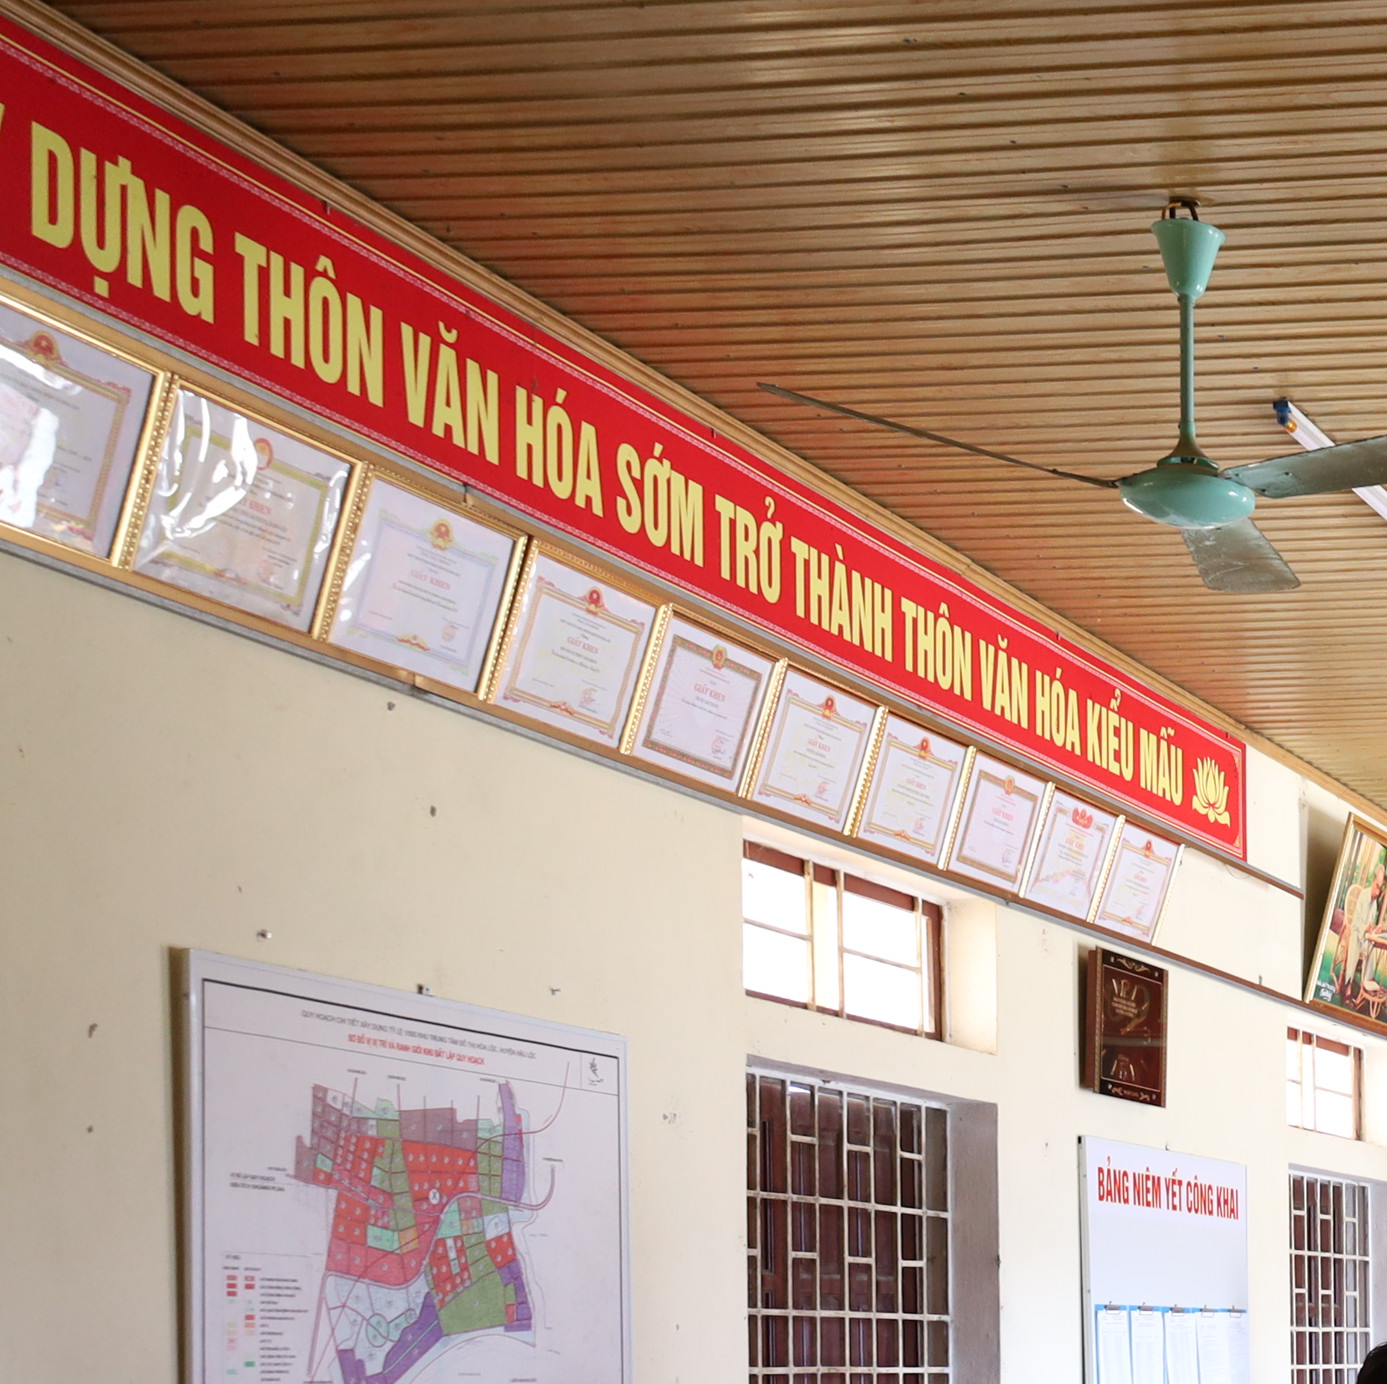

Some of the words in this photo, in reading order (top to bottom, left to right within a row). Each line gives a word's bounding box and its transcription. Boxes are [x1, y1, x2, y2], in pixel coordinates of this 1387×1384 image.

[31, 120, 214, 324] DỰNG
[234, 232, 384, 408] THÔN
[400, 321, 500, 466] VĂN
[515, 386, 604, 517] HÓA
[615, 441, 704, 568] SỚM
[716, 496, 782, 604] TRỞ
[791, 541, 894, 663] THÀNH
[901, 597, 972, 702] THÔN
[979, 636, 1030, 731] VĂN
[1034, 661, 1081, 756] HÓA
[1086, 688, 1134, 782] KIỂU
[1139, 723, 1183, 807] MẪU
[1098, 1156, 1129, 1204] BẢNG
[1133, 1167, 1161, 1209] NIÊM
[1165, 1168, 1183, 1212] YẾT
[1186, 1175, 1213, 1216] CÔNG
[1217, 1186, 1239, 1220] KHAI
